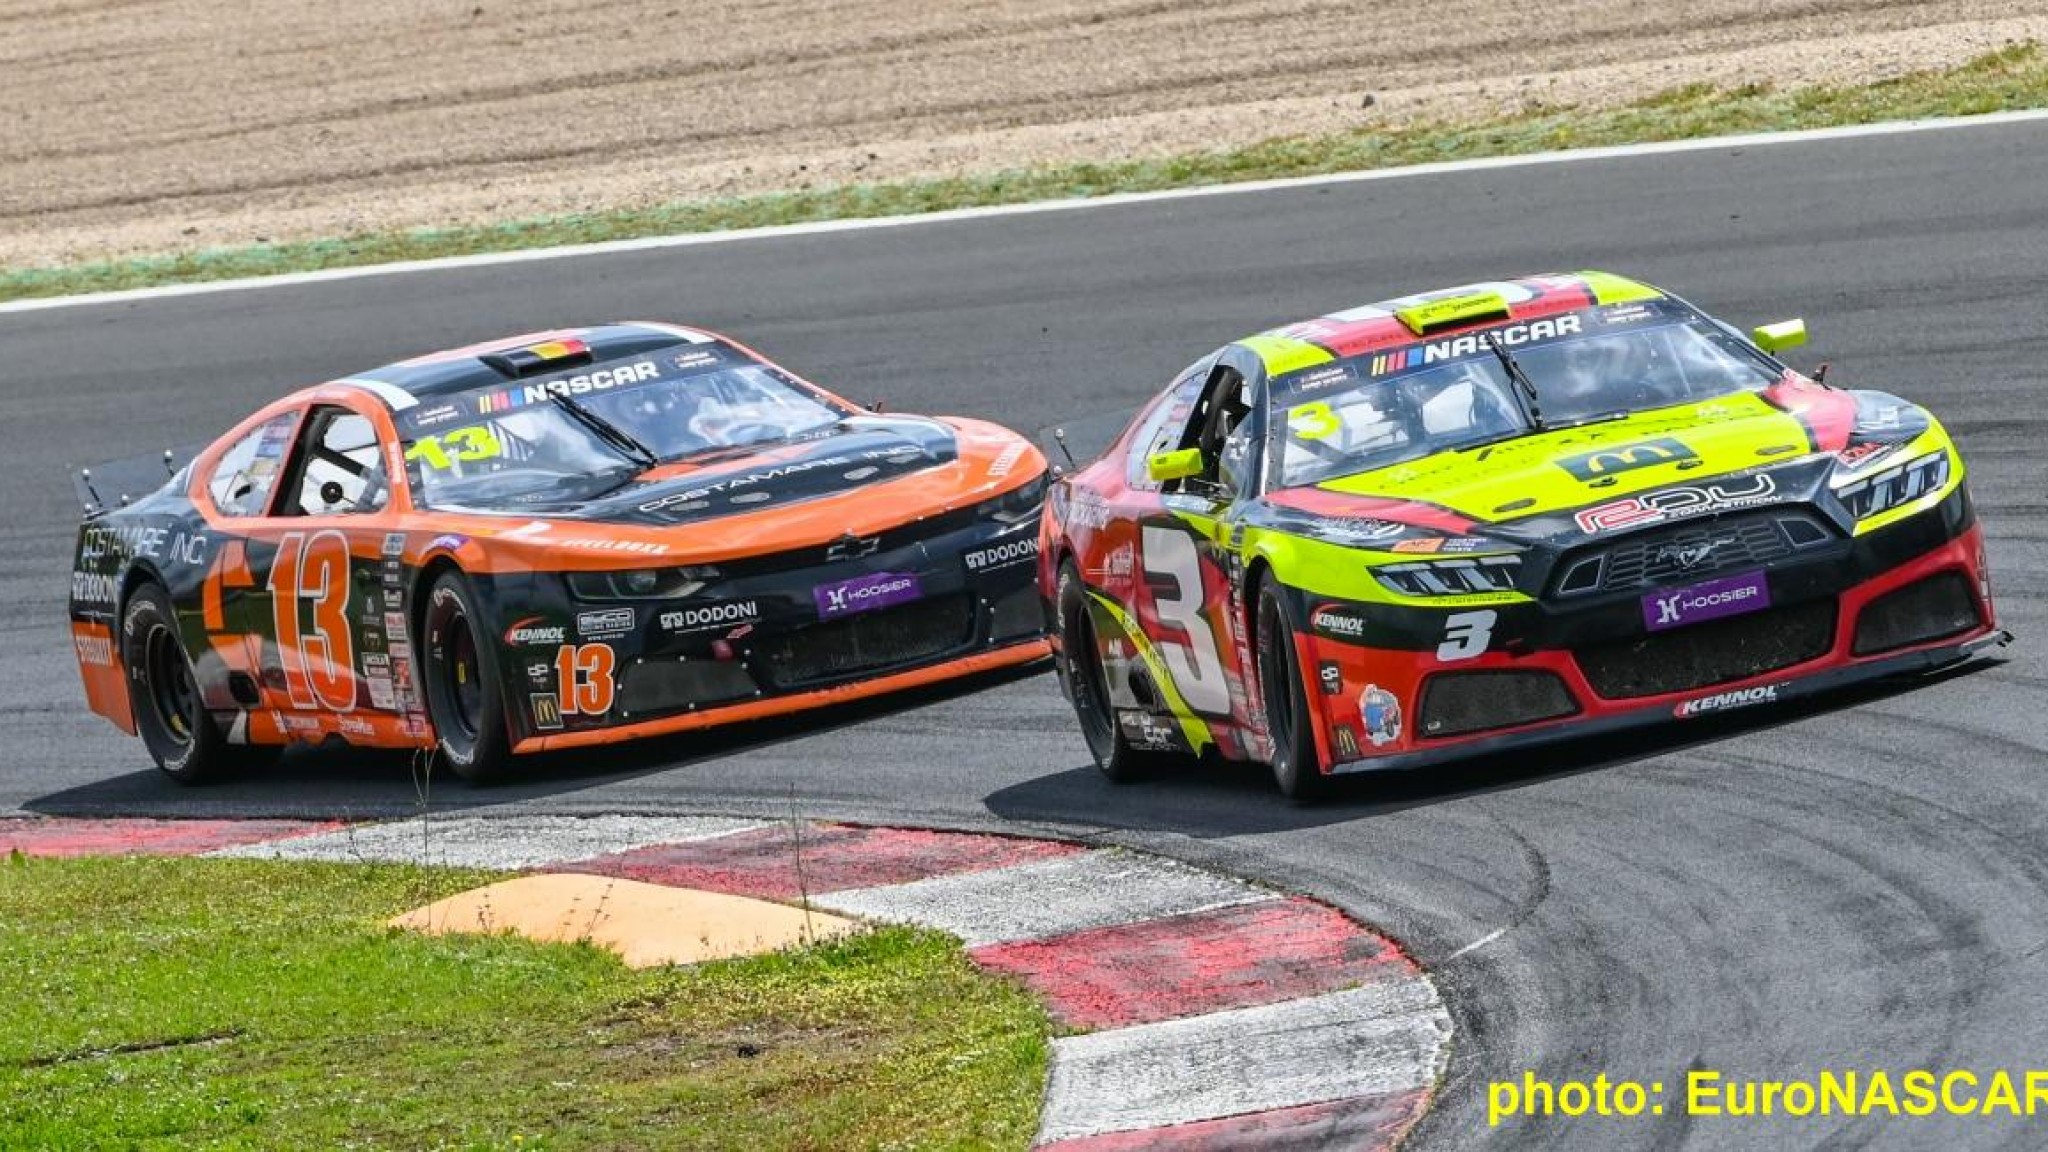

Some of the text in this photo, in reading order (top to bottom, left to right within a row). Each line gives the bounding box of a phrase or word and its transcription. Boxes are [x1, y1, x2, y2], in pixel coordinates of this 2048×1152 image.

[1424, 312, 1582, 364] NASCAR
[524, 361, 660, 404] NASCAR
[1289, 401, 1342, 440] 3
[404, 426, 500, 470] 13
[987, 537, 1039, 564] DODON
[848, 578, 911, 601] HOOSIER
[1681, 585, 1758, 611] HOOSIER
[265, 529, 357, 713] 13
[685, 600, 758, 625] DODONI
[1141, 525, 1231, 716] 3
[1313, 612, 1365, 632] KENNOL
[511, 626, 567, 642] KENNOL
[1437, 609, 1497, 660] 3
[553, 642, 616, 716] 13
[1681, 685, 1778, 716] KENNOL
